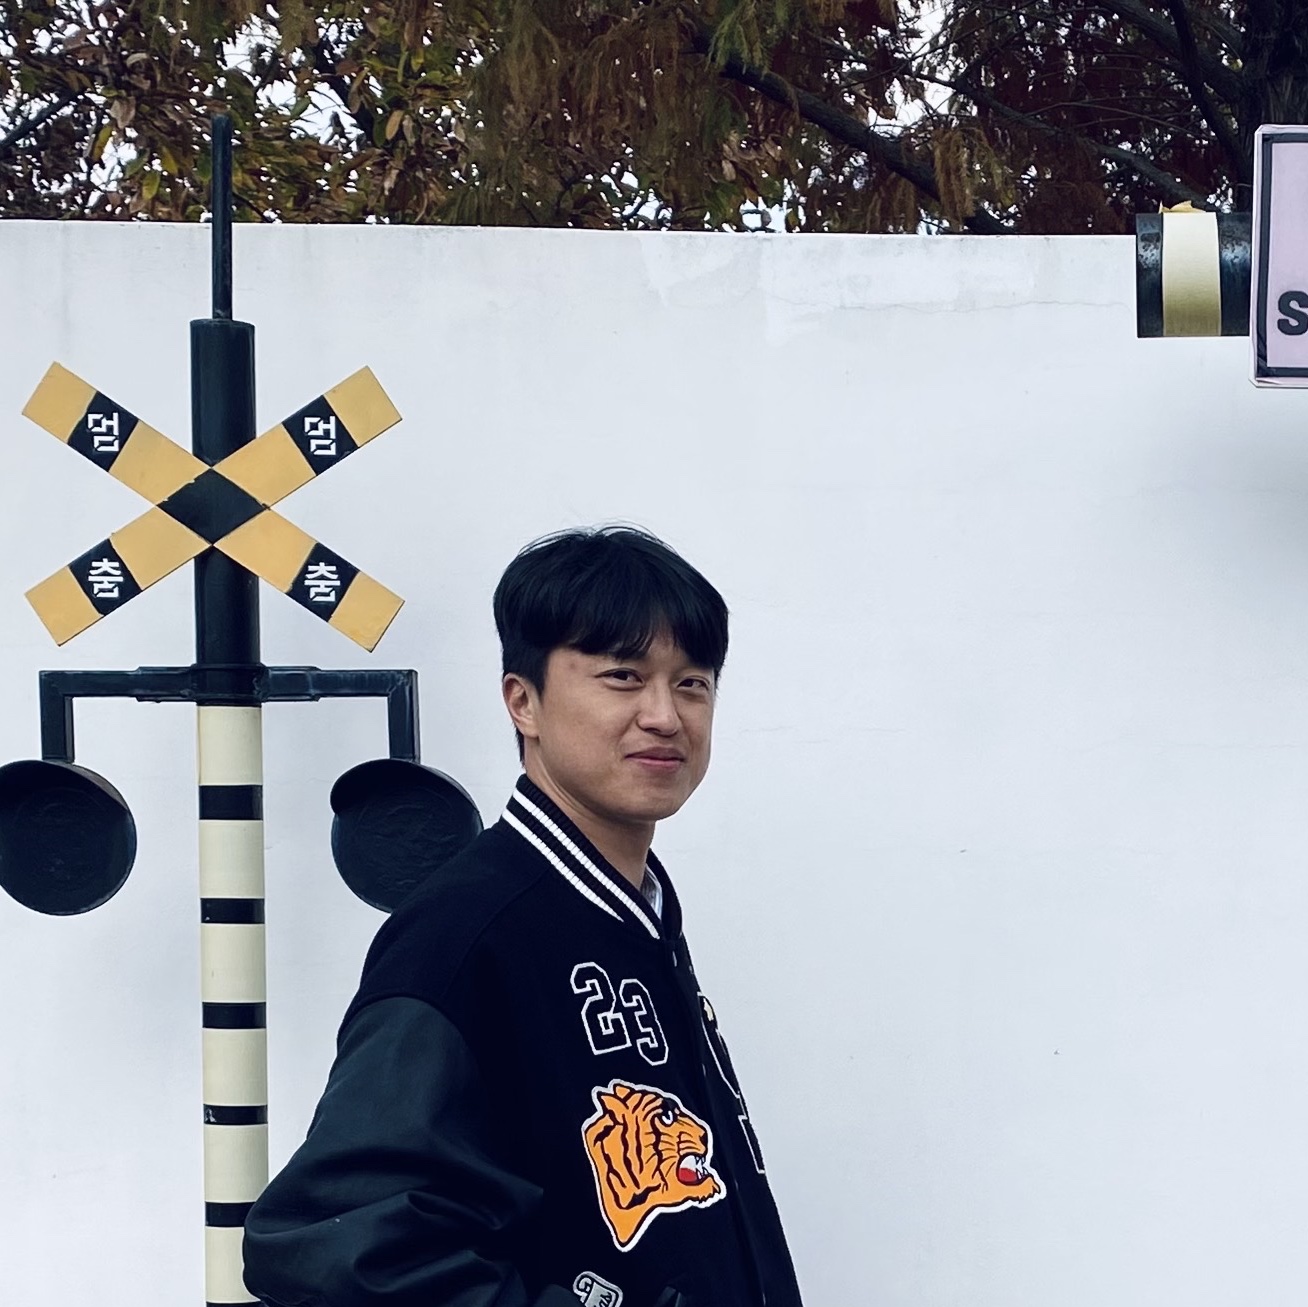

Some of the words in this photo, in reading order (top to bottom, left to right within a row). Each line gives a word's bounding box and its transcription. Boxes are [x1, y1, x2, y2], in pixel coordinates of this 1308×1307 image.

[87, 411, 119, 452] 멈
[304, 415, 336, 456] 멈
[88, 557, 124, 598] 춤
[303, 561, 341, 602] 춤
[569, 961, 669, 1067] 23
